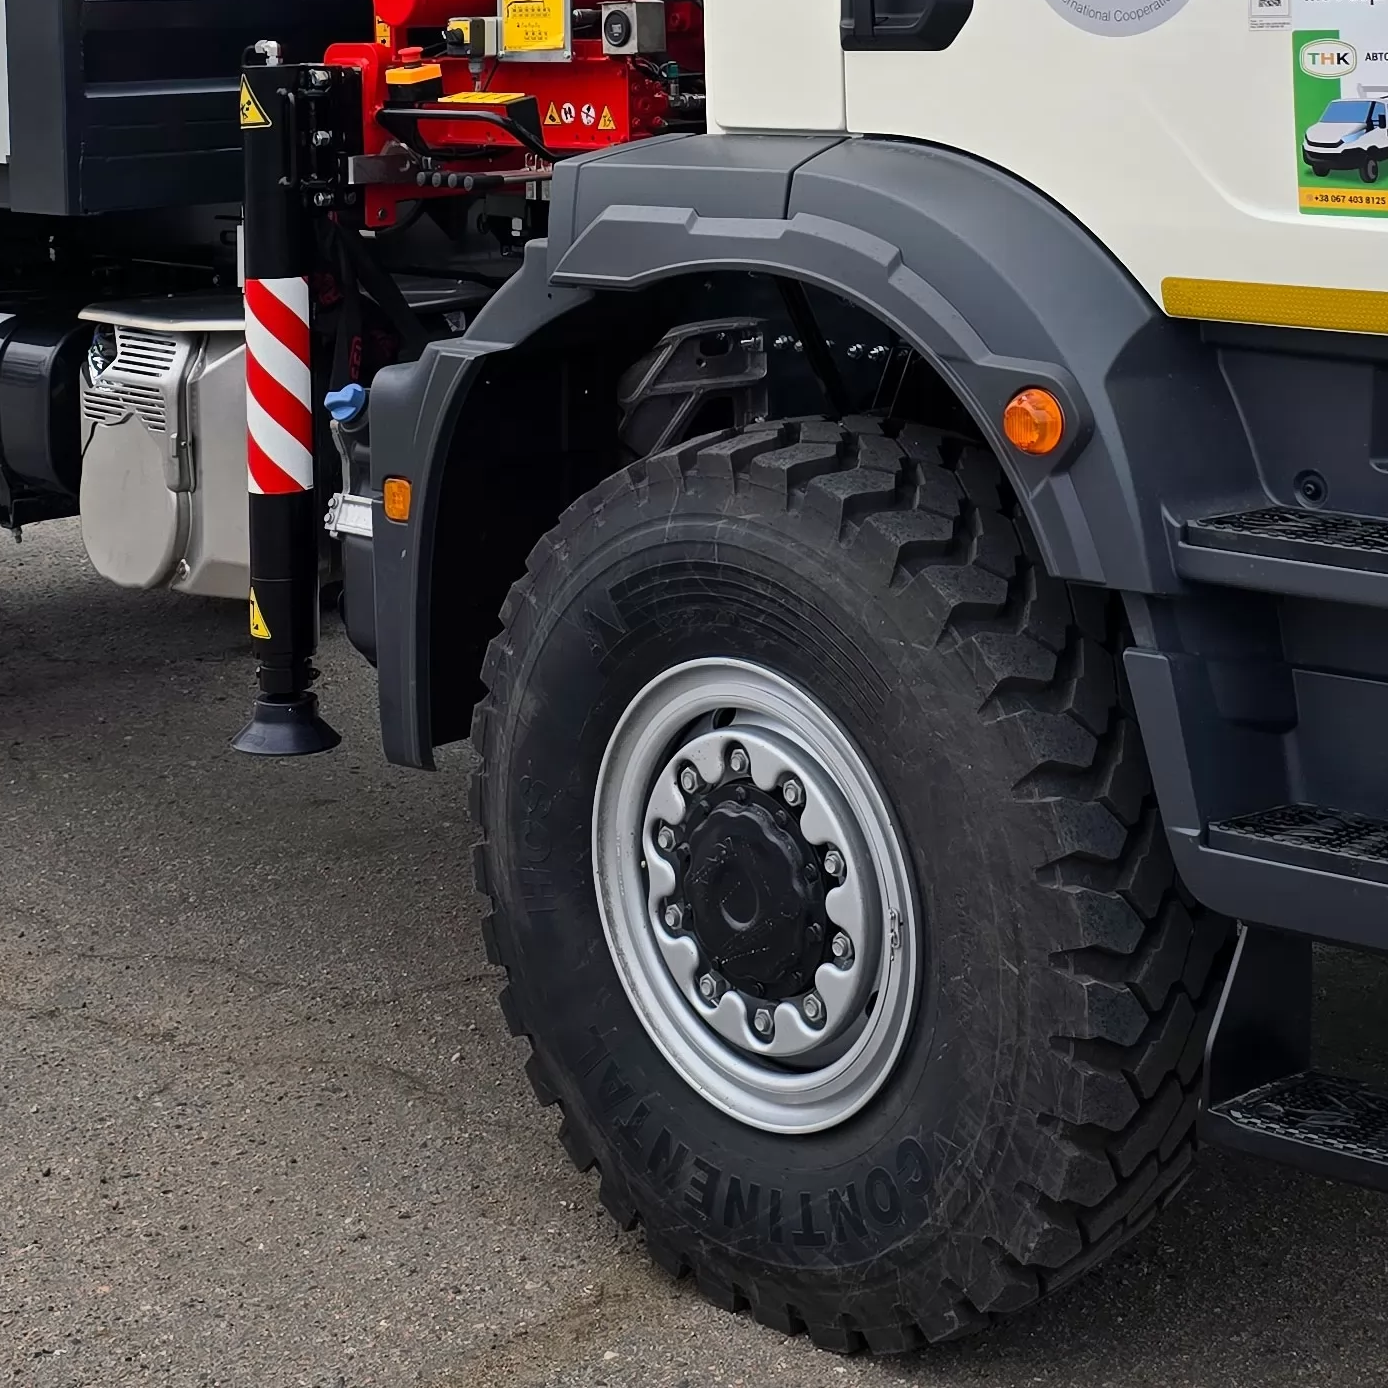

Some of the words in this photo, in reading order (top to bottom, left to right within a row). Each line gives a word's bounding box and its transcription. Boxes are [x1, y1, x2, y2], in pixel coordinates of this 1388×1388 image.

[1315, 194, 1329, 202] +38
[1331, 194, 1346, 203] 067
[1348, 195, 1363, 204] 403
[1365, 196, 1386, 205] 8125
[578, 1023, 936, 1249] CONTINENTAL
